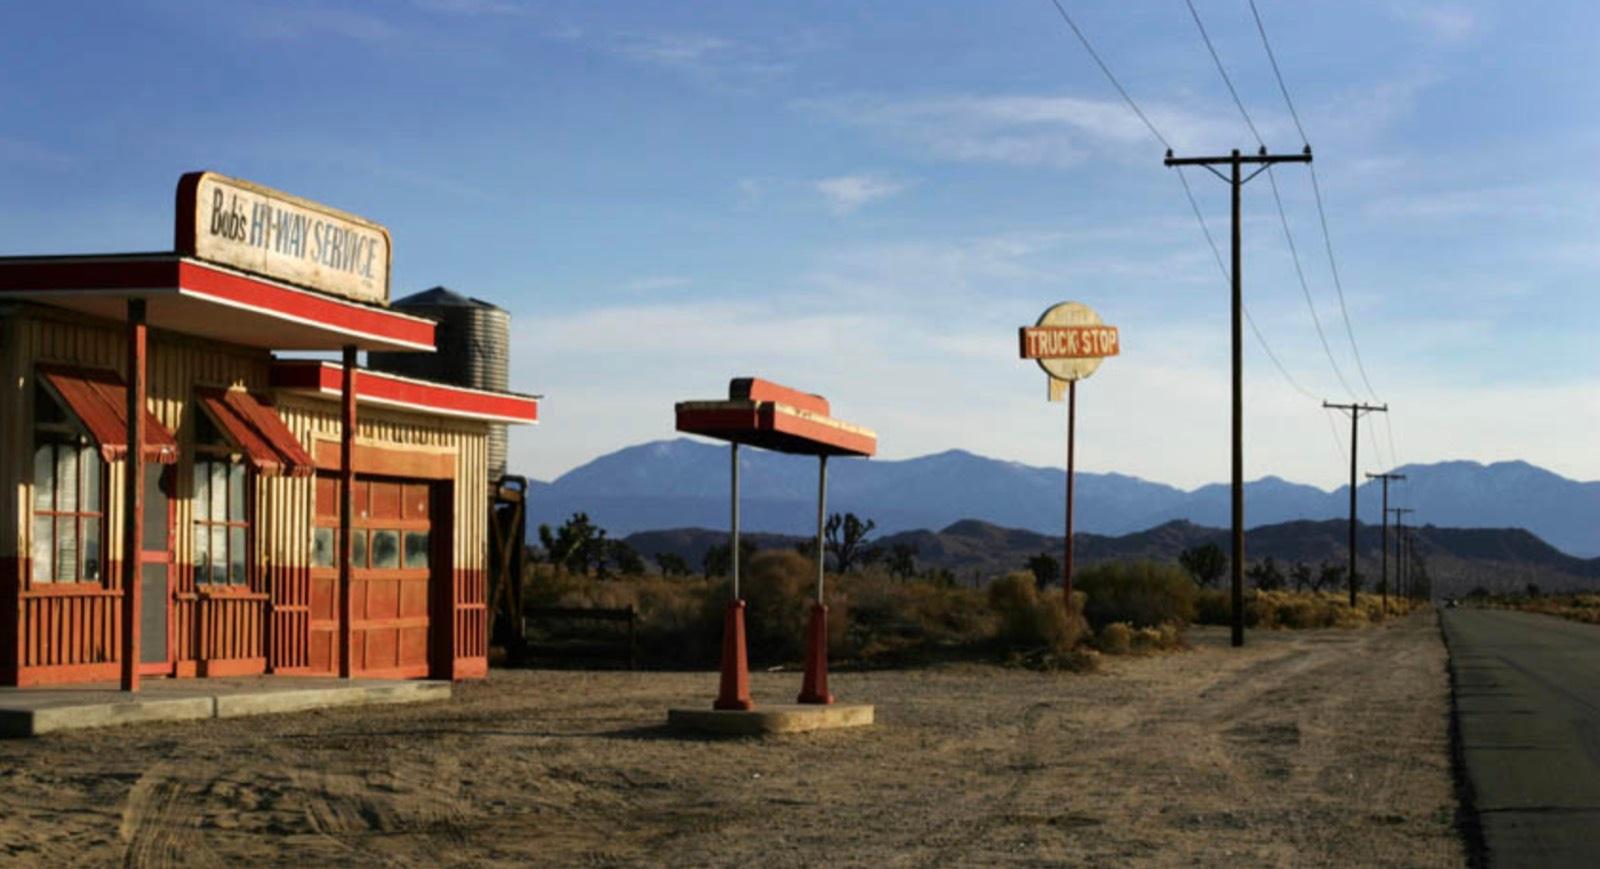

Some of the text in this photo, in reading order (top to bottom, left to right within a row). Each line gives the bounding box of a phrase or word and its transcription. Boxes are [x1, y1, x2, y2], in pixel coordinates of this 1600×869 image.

[210, 187, 378, 278] Bob's HI-WAY SERVICE
[1028, 329, 1116, 355] TRUCK STOP
